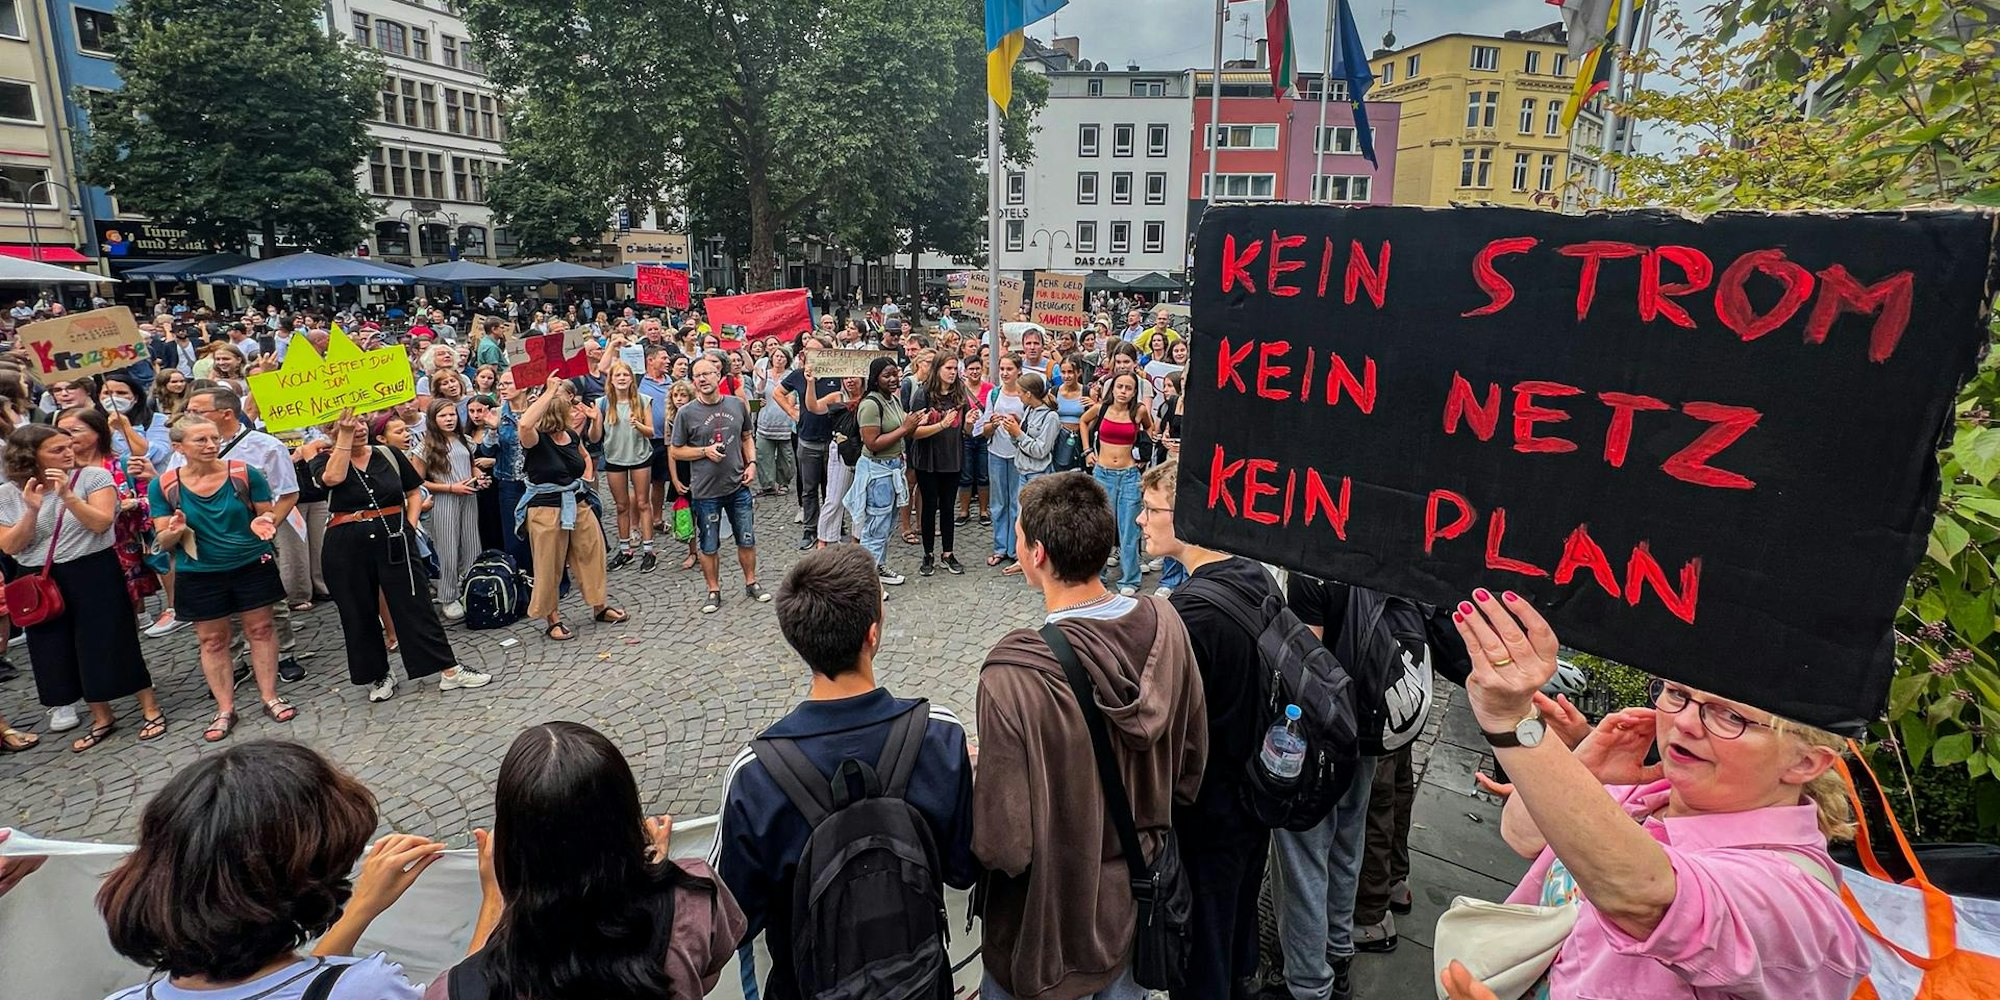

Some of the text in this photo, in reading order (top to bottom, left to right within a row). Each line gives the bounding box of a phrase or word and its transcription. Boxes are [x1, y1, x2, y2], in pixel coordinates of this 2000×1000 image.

[141, 225, 188, 237] Tünne
[137, 238, 166, 250] und
[1075, 256, 1126, 266] DAS CAFÉ
[1036, 279, 1083, 290] MEHR GELD
[1222, 231, 1914, 363] KEIN STROM
[1035, 301, 1076, 311] KREUZGASSE
[1038, 313, 1082, 326] SANIEREN
[30, 340, 149, 373] Kreuzgasse
[318, 358, 365, 377] RETTET
[368, 354, 394, 369] DEN
[324, 375, 350, 390] DOM
[269, 401, 309, 421] ABER
[311, 393, 346, 417] NICHT
[1217, 338, 1762, 490] KEIN NETZ
[1208, 445, 1702, 624] KEIN PLAN
